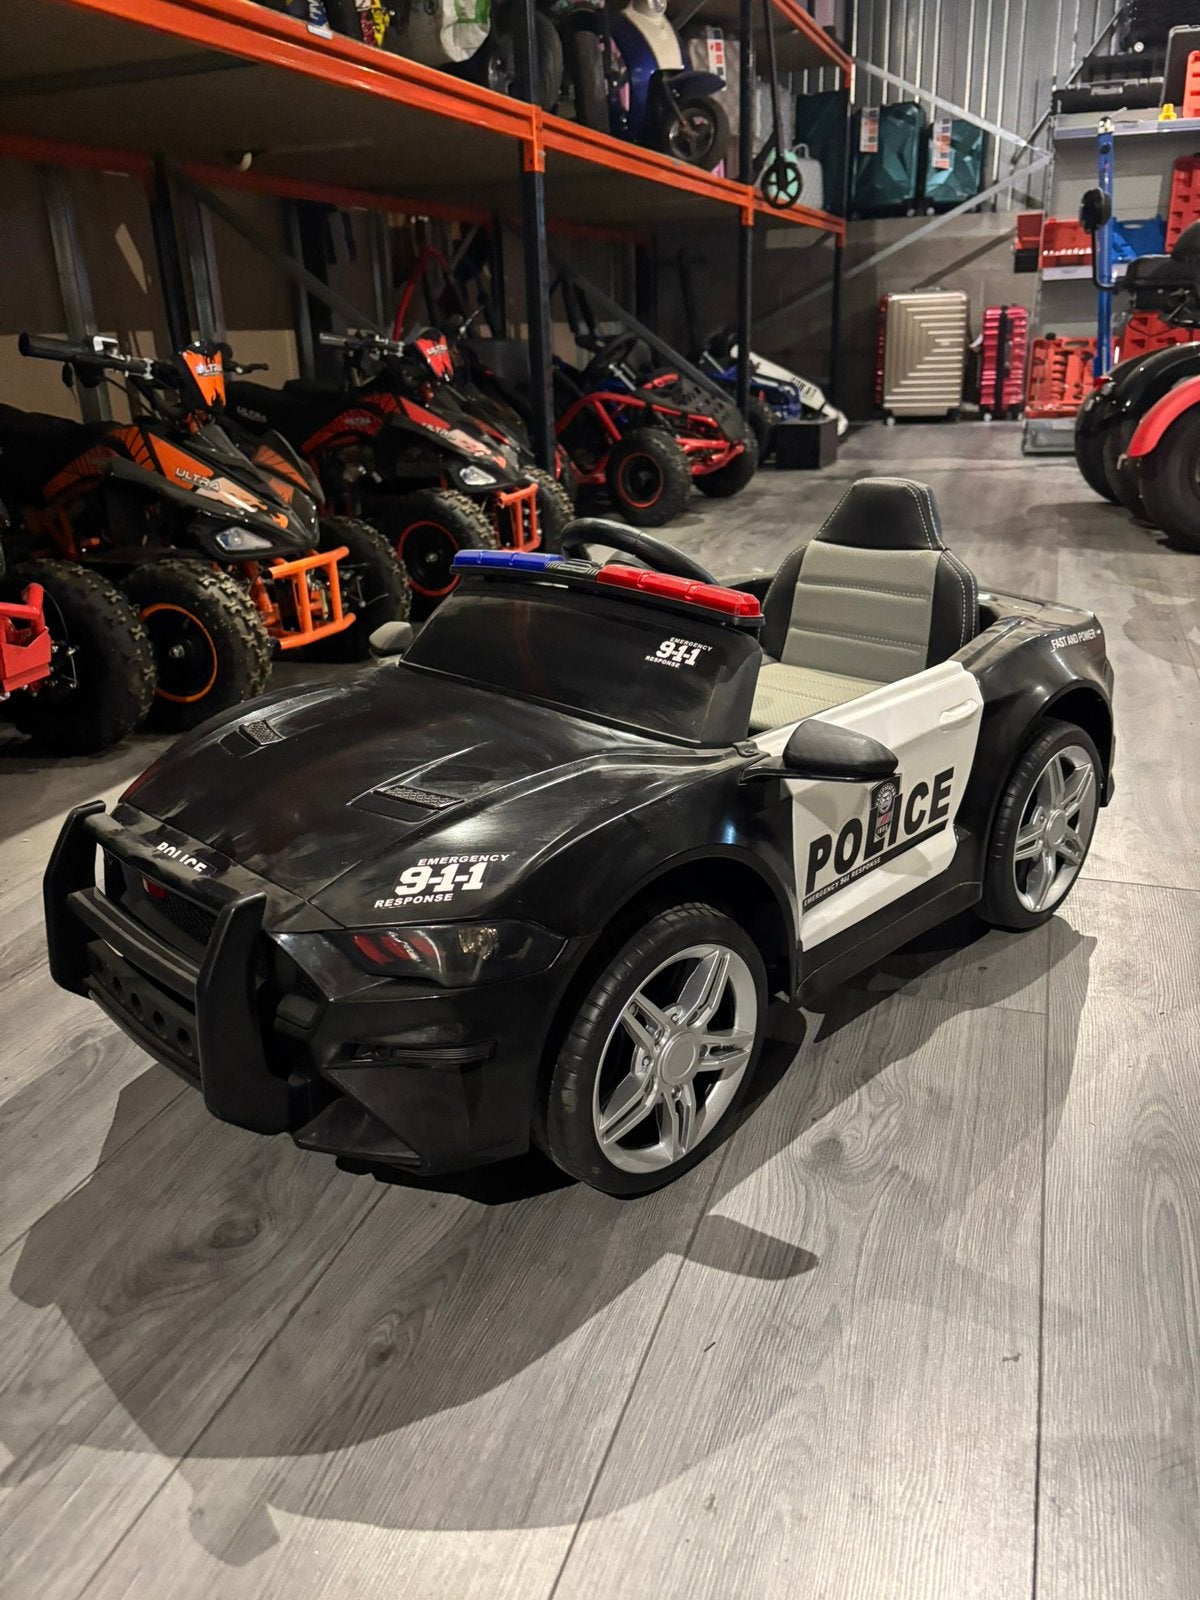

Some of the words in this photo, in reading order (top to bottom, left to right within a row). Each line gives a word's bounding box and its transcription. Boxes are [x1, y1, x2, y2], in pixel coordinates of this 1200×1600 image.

[176, 467, 220, 492] ULTRA
[669, 637, 713, 652] EMERGENCY
[1051, 636, 1067, 649] FAST
[1067, 634, 1078, 645] AND
[645, 655, 680, 668] RESPONSE
[805, 767, 954, 896] POLICE
[418, 854, 510, 866] EMERGENCY
[804, 881, 839, 906] EMERGENCY
[851, 857, 881, 878] RESPONSE
[374, 893, 454, 908] RESPONSE
